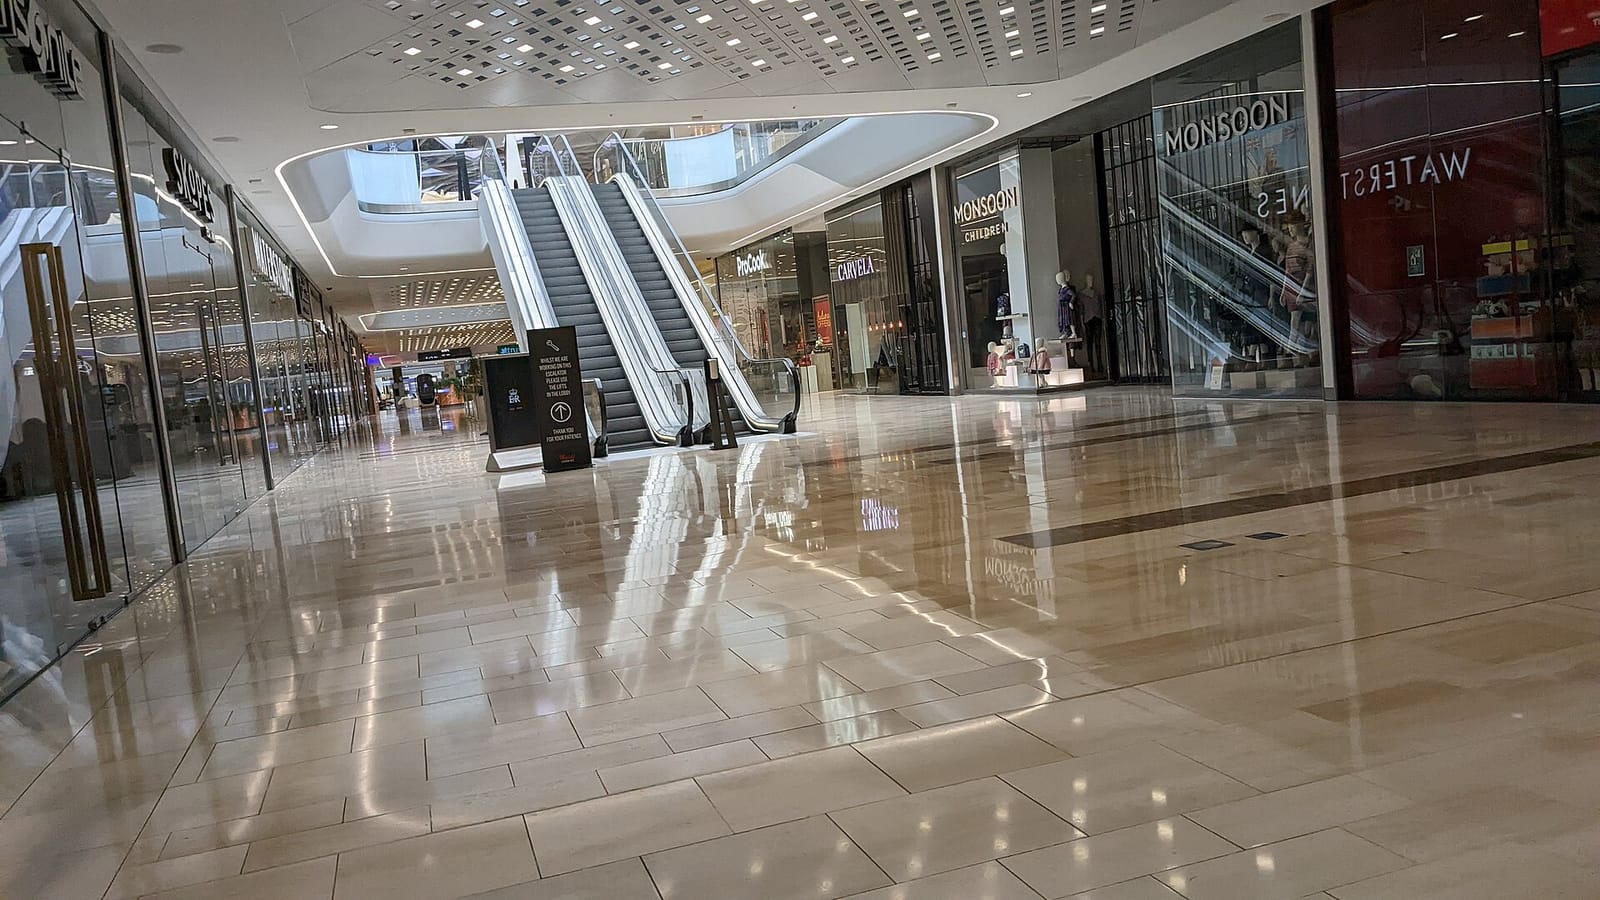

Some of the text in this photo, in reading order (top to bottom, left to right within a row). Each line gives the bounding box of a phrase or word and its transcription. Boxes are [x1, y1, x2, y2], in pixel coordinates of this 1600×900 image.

[1165, 93, 1289, 157] MONSOON
[172, 147, 216, 222] SKOPES
[953, 186, 1018, 225] MONSOON
[736, 249, 768, 277] ProCook
[837, 255, 875, 281] CARVELA
